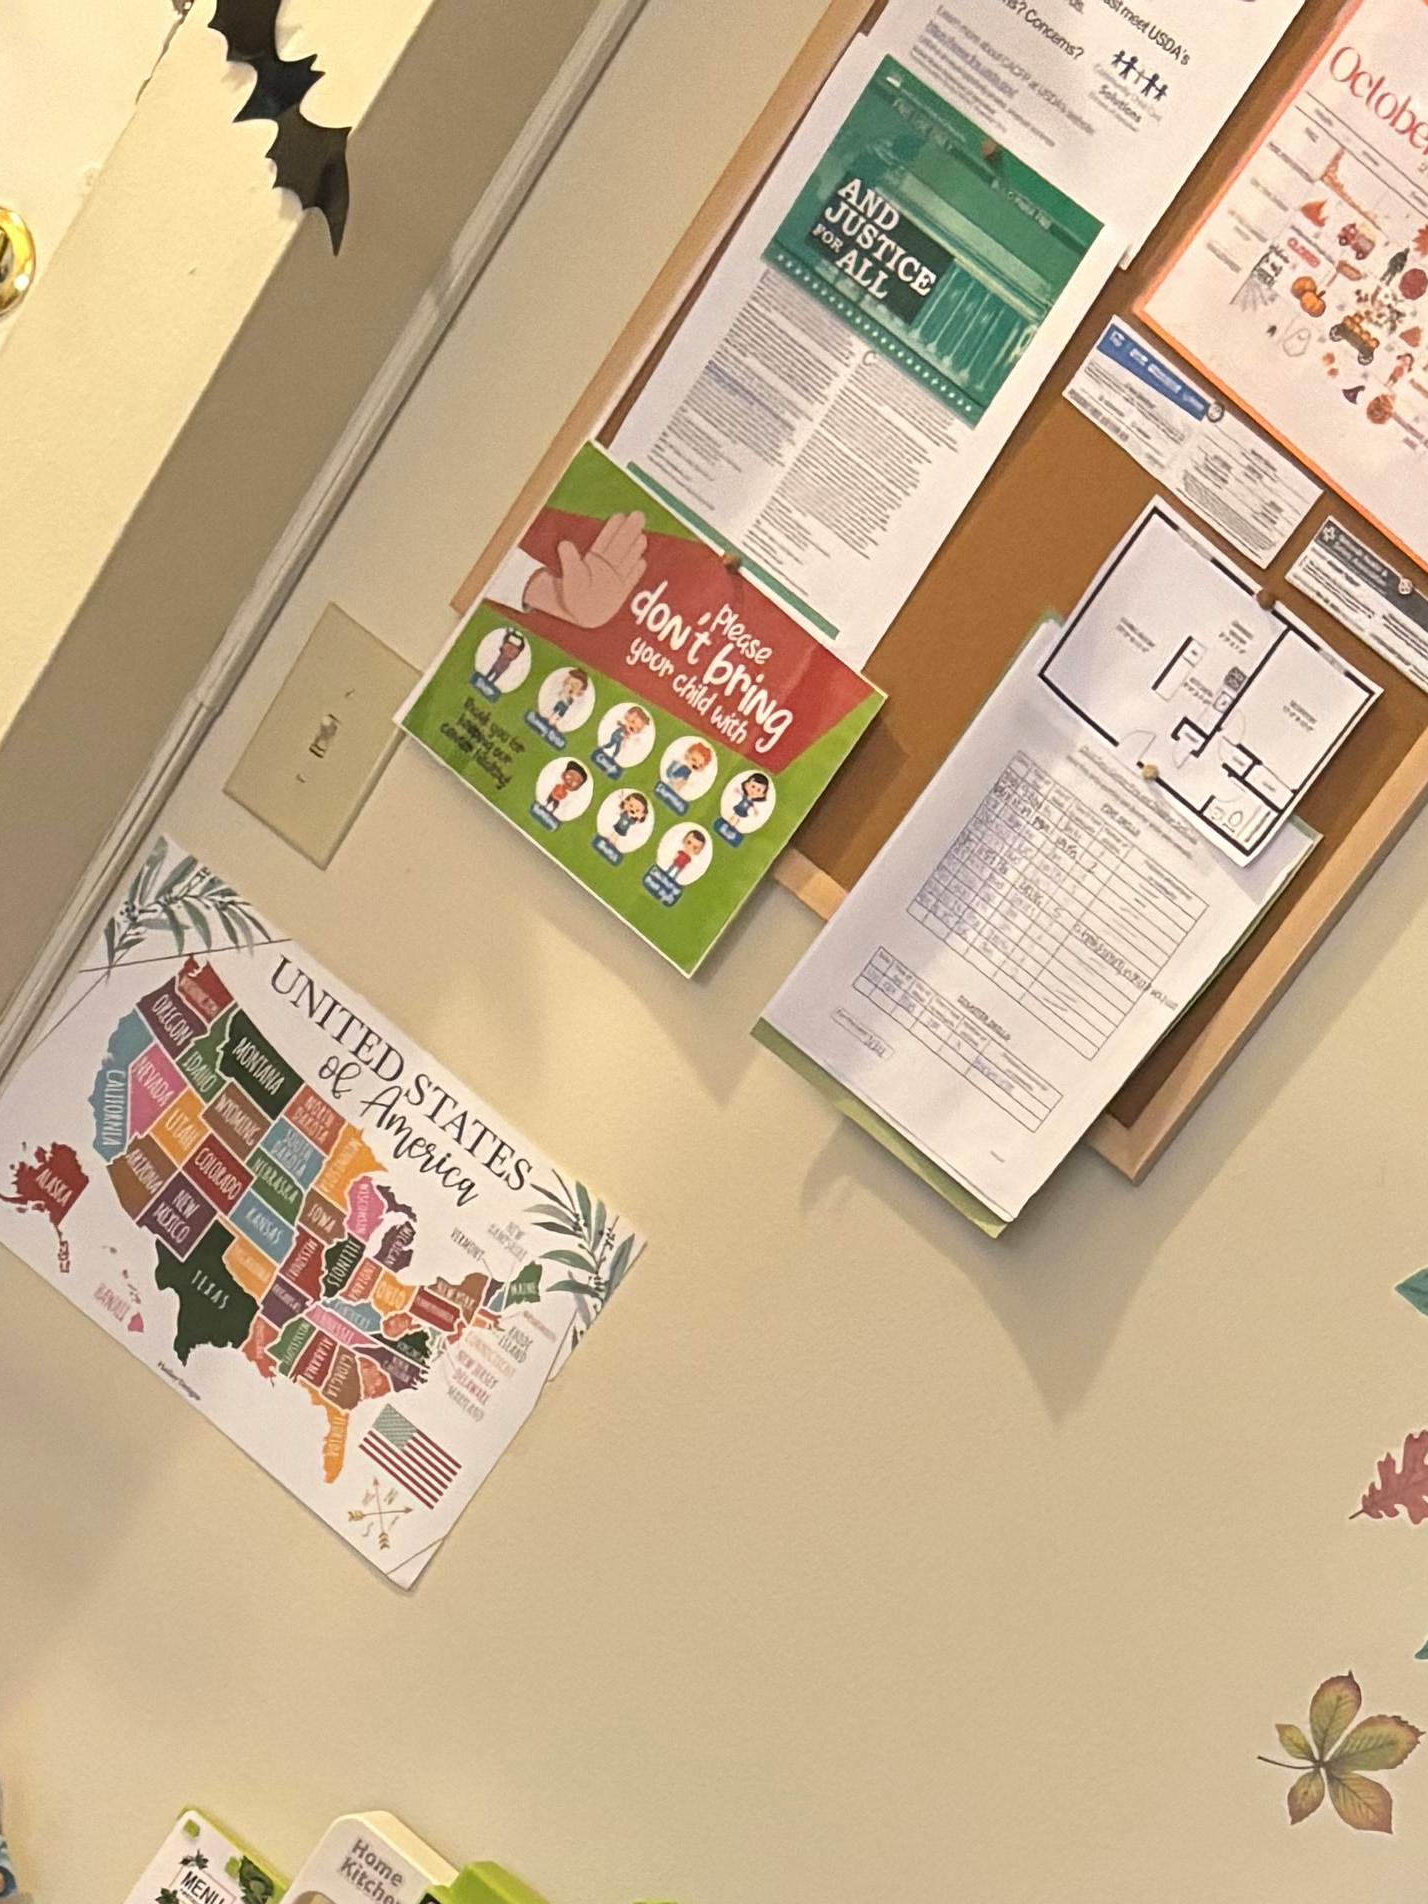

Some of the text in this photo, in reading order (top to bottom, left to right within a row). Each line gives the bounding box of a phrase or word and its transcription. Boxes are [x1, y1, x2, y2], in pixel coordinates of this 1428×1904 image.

[1147, 26, 1194, 67] USDA's
[1098, 84, 1144, 124] Solutions
[836, 174, 902, 233] AND
[812, 224, 892, 299] FOR ALL
[823, 199, 938, 295] JUSTICE
[709, 605, 773, 665] Please
[630, 582, 795, 751] don't bring
[625, 636, 754, 747] your child with
[486, 721, 511, 745] you
[152, 992, 195, 1048] OREGON
[132, 1054, 176, 1109] NEVADA
[182, 1049, 216, 1094] IDAHO
[231, 1036, 286, 1095] MONTANA
[270, 956, 532, 1190] UNITED STATES
[107, 1067, 123, 1149] CALIFORNIA
[165, 1108, 199, 1152] UTAH
[211, 1092, 263, 1147] WYOMING
[292, 1107, 330, 1144] DAKOTA
[318, 1055, 477, 1206] of America
[125, 1145, 166, 1196] ARIZONA
[193, 1145, 245, 1201] COLORADO
[250, 1156, 300, 1203] NEBRASKA
[269, 1140, 307, 1179] DAKOTA
[35, 1167, 74, 1206] ALASKA
[172, 1187, 201, 1220] NEW
[152, 1202, 191, 1245] MEXICO
[243, 1206, 284, 1246] KANSAS
[307, 1203, 337, 1233] IOWA
[325, 1241, 366, 1287] ILLINOIS
[449, 1231, 484, 1262] VERMONT
[191, 1270, 229, 1309] TEXAS
[352, 1840, 405, 1886] Home
